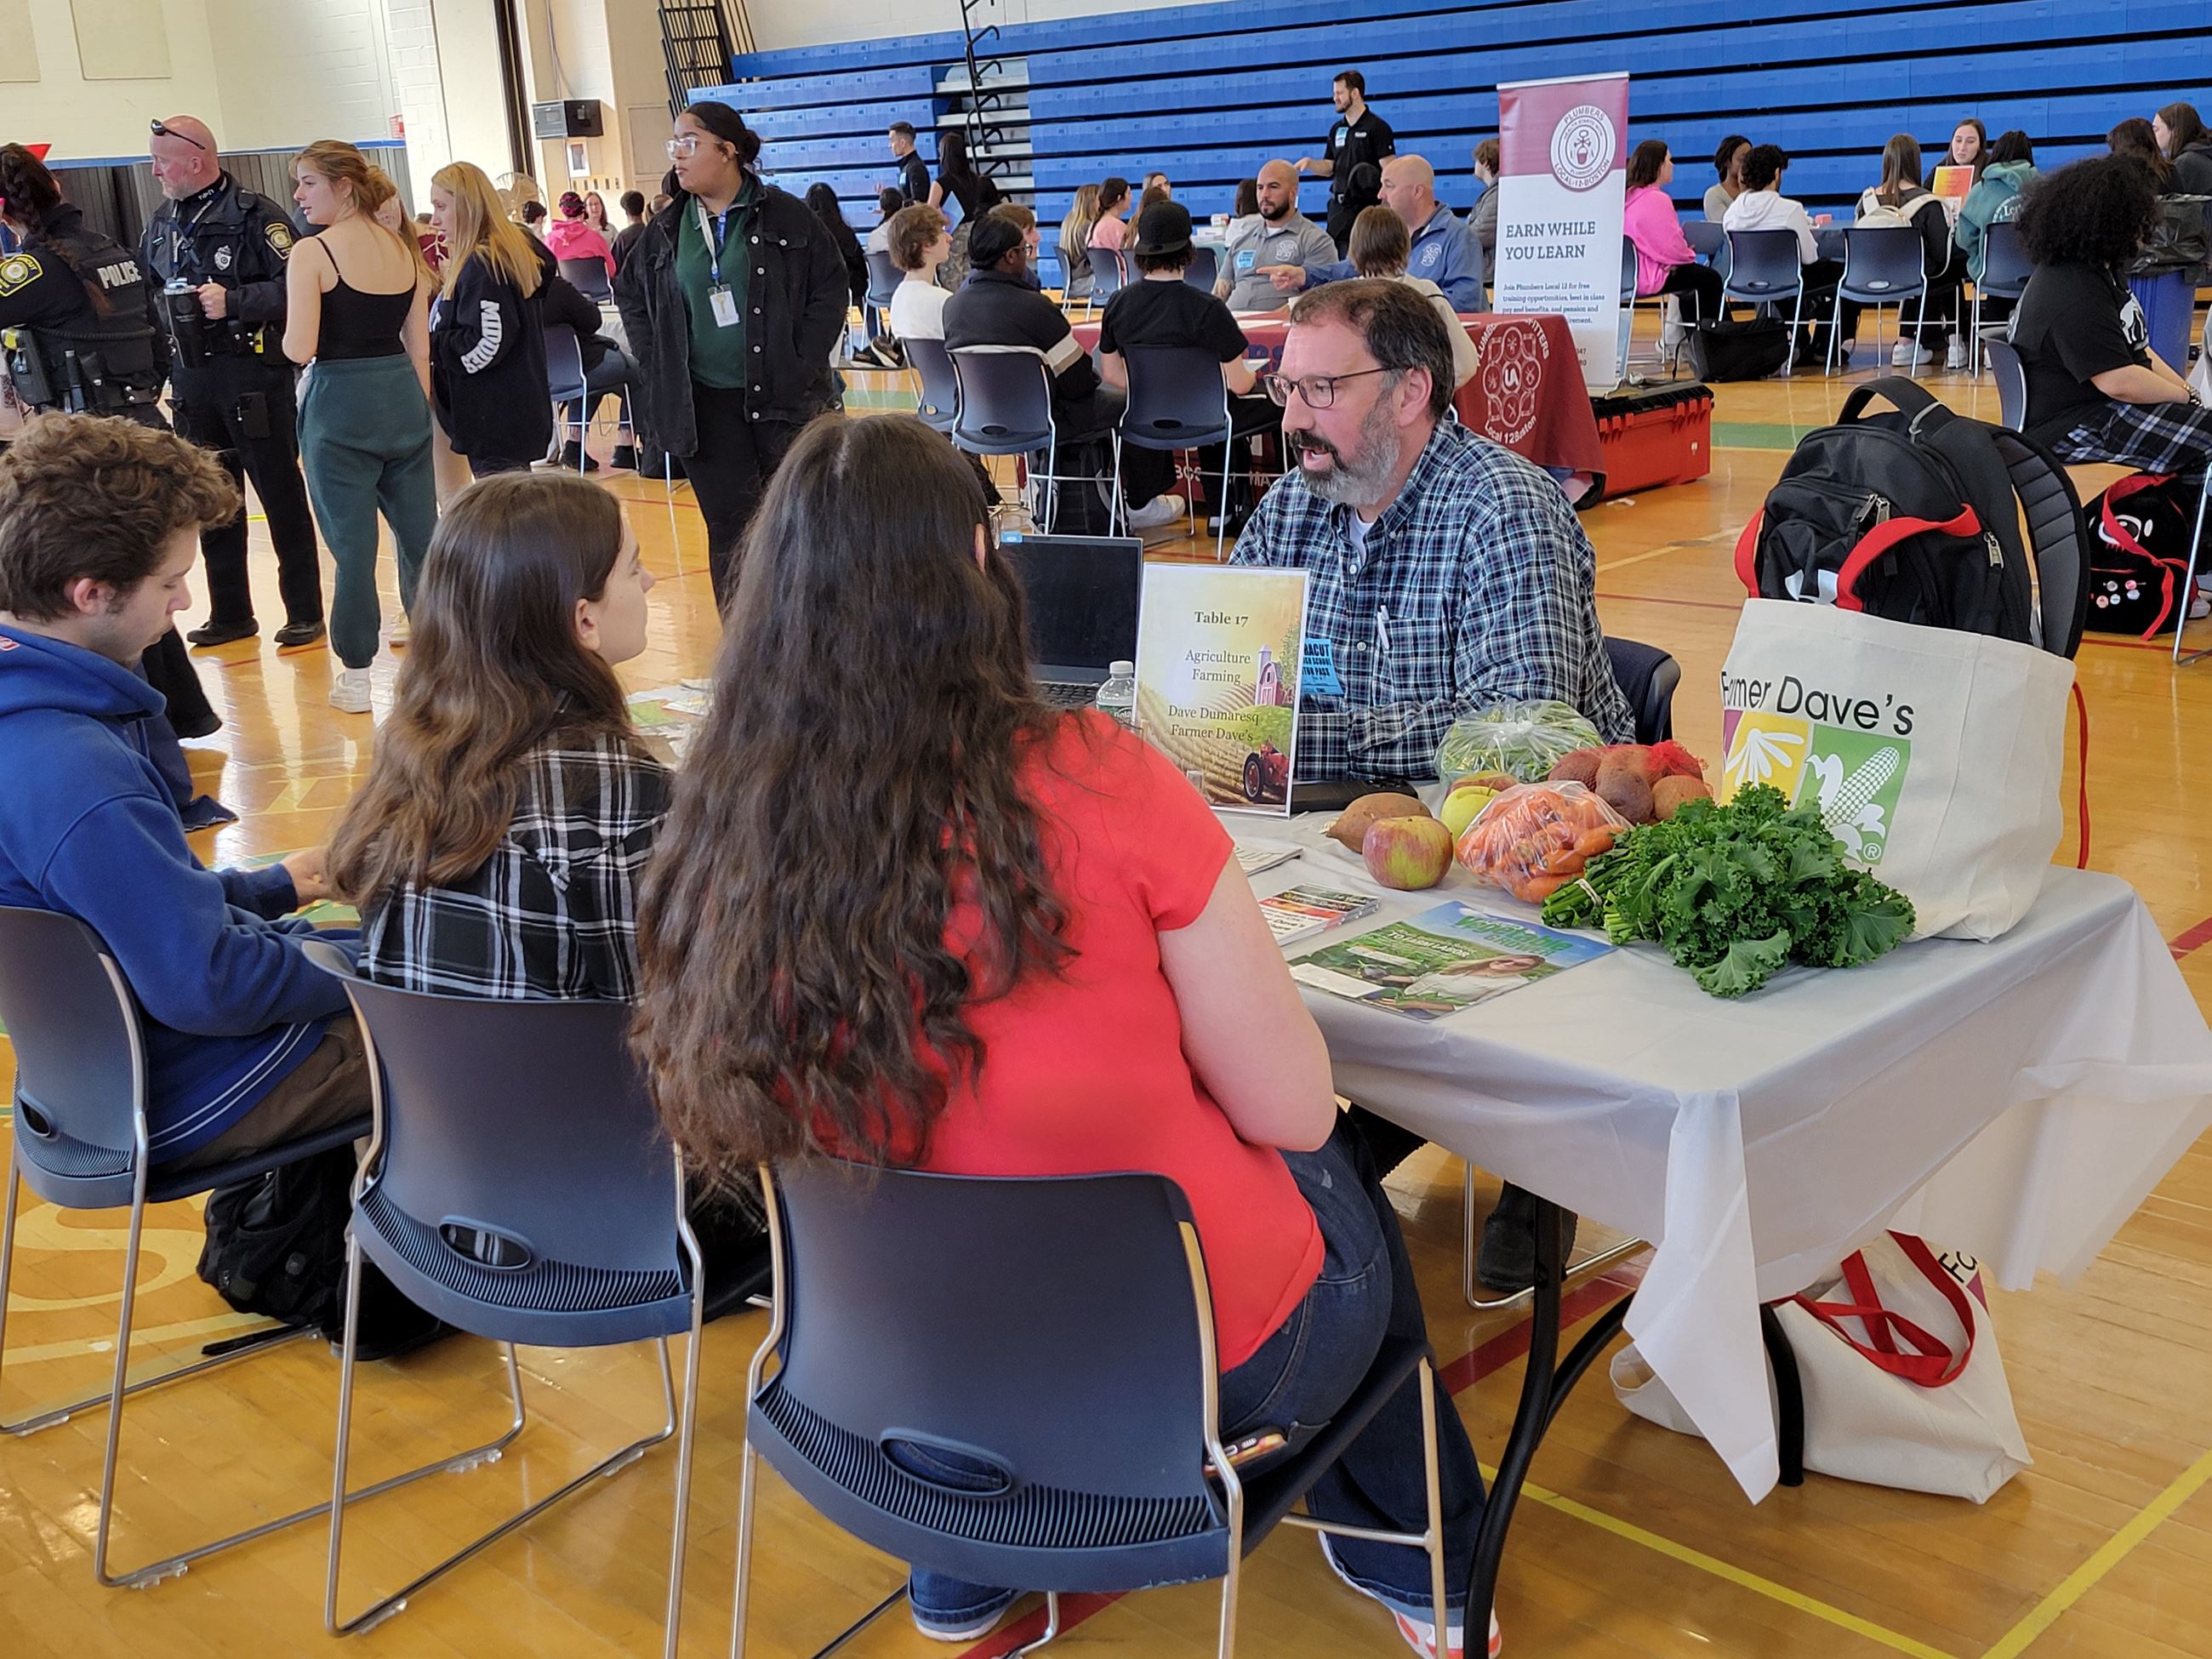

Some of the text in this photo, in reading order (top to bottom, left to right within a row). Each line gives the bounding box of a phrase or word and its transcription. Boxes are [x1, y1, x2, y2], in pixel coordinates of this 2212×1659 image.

[1564, 106, 1605, 123] PLUMBERS
[1506, 221, 1595, 238] EARN WHILE
[1505, 244, 1586, 260] YOU LEARN
[97, 259, 142, 289] POLICE
[460, 299, 501, 373] MIDDIES
[1194, 611, 1249, 628] Table 17
[1185, 649, 1251, 664] Agriculture
[1304, 643, 1330, 657] RACUT
[1192, 668, 1240, 687] Farming
[1776, 676, 1914, 735] Dave's
[1168, 704, 1259, 727] Dave Dumaresq
[1170, 724, 1254, 743] Farmer Dave's
